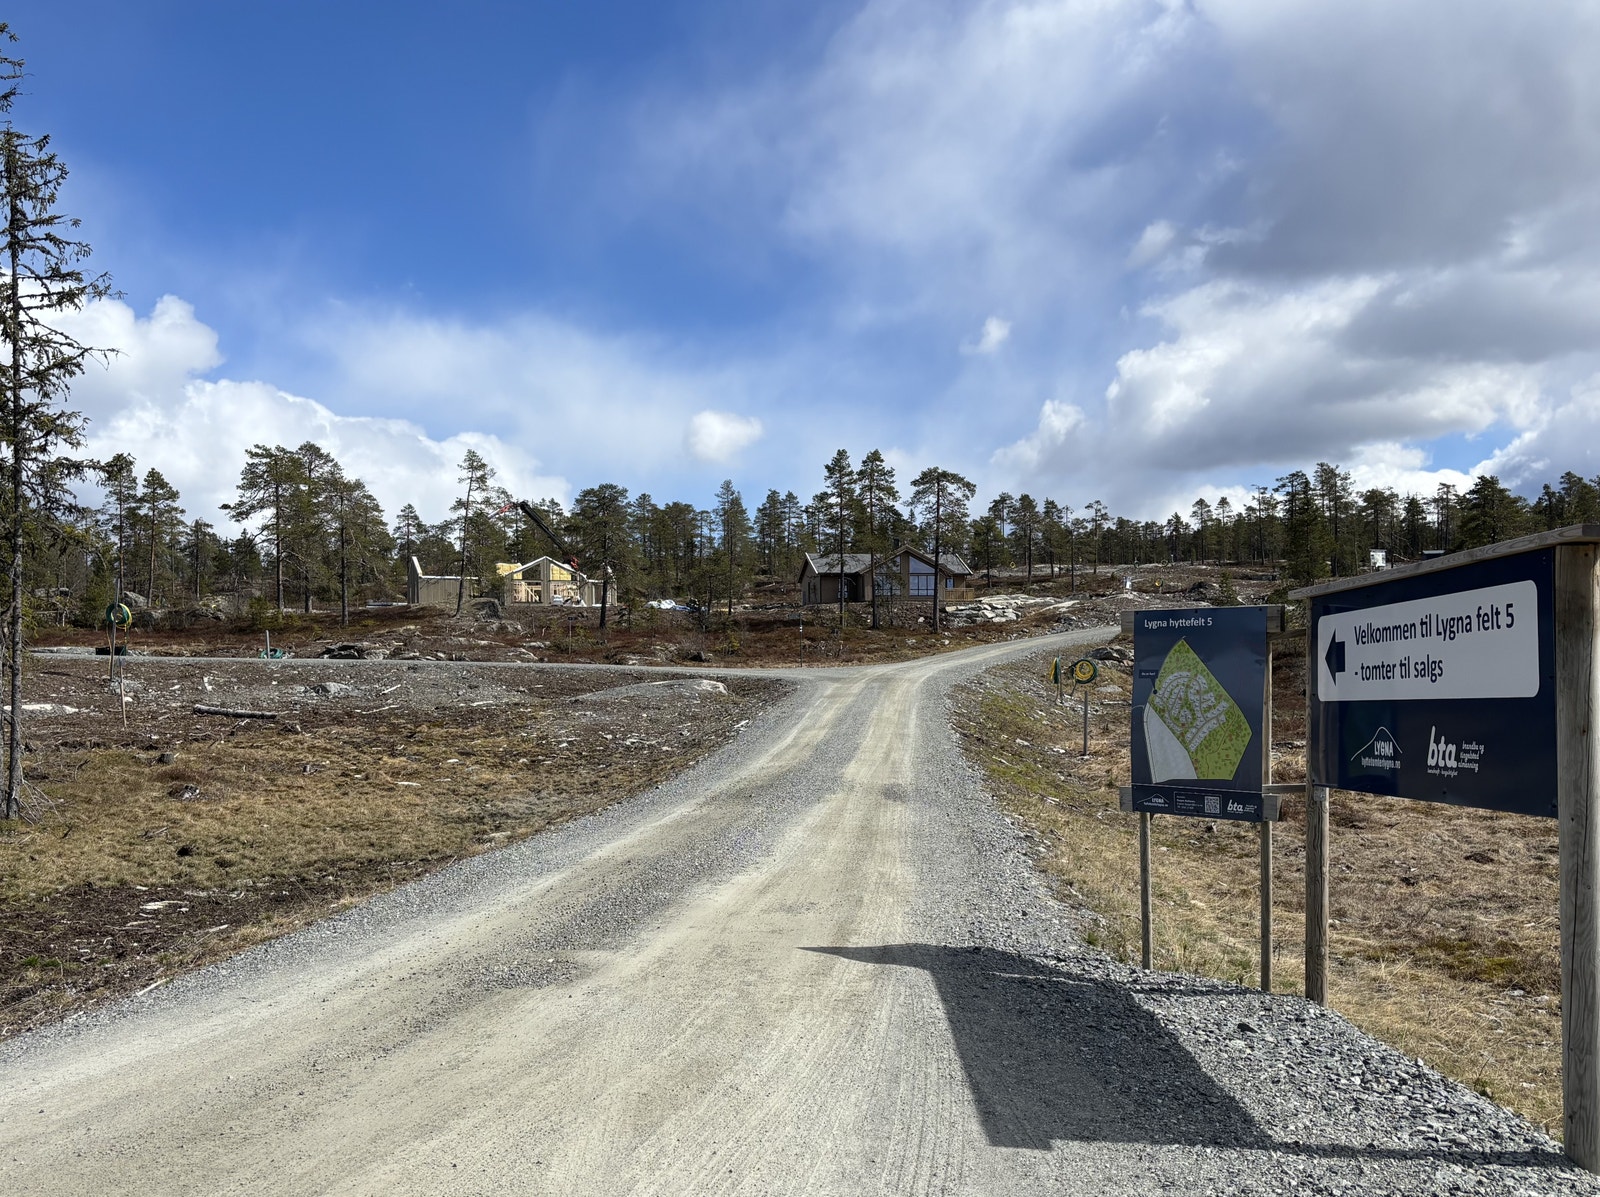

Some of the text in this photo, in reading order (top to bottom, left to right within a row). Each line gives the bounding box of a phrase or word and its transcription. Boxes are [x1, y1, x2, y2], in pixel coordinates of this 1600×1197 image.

[1144, 617, 1213, 629] Lygna hyttefelt 5
[1354, 603, 1515, 646] Velkommen til Lygna felt 5
[1361, 660, 1397, 681] tomter
[1399, 656, 1411, 679] til
[1413, 654, 1444, 683] salgs
[1374, 740, 1394, 757] LYGNA
[1427, 725, 1458, 768] bta
[1227, 799, 1244, 812] bta
